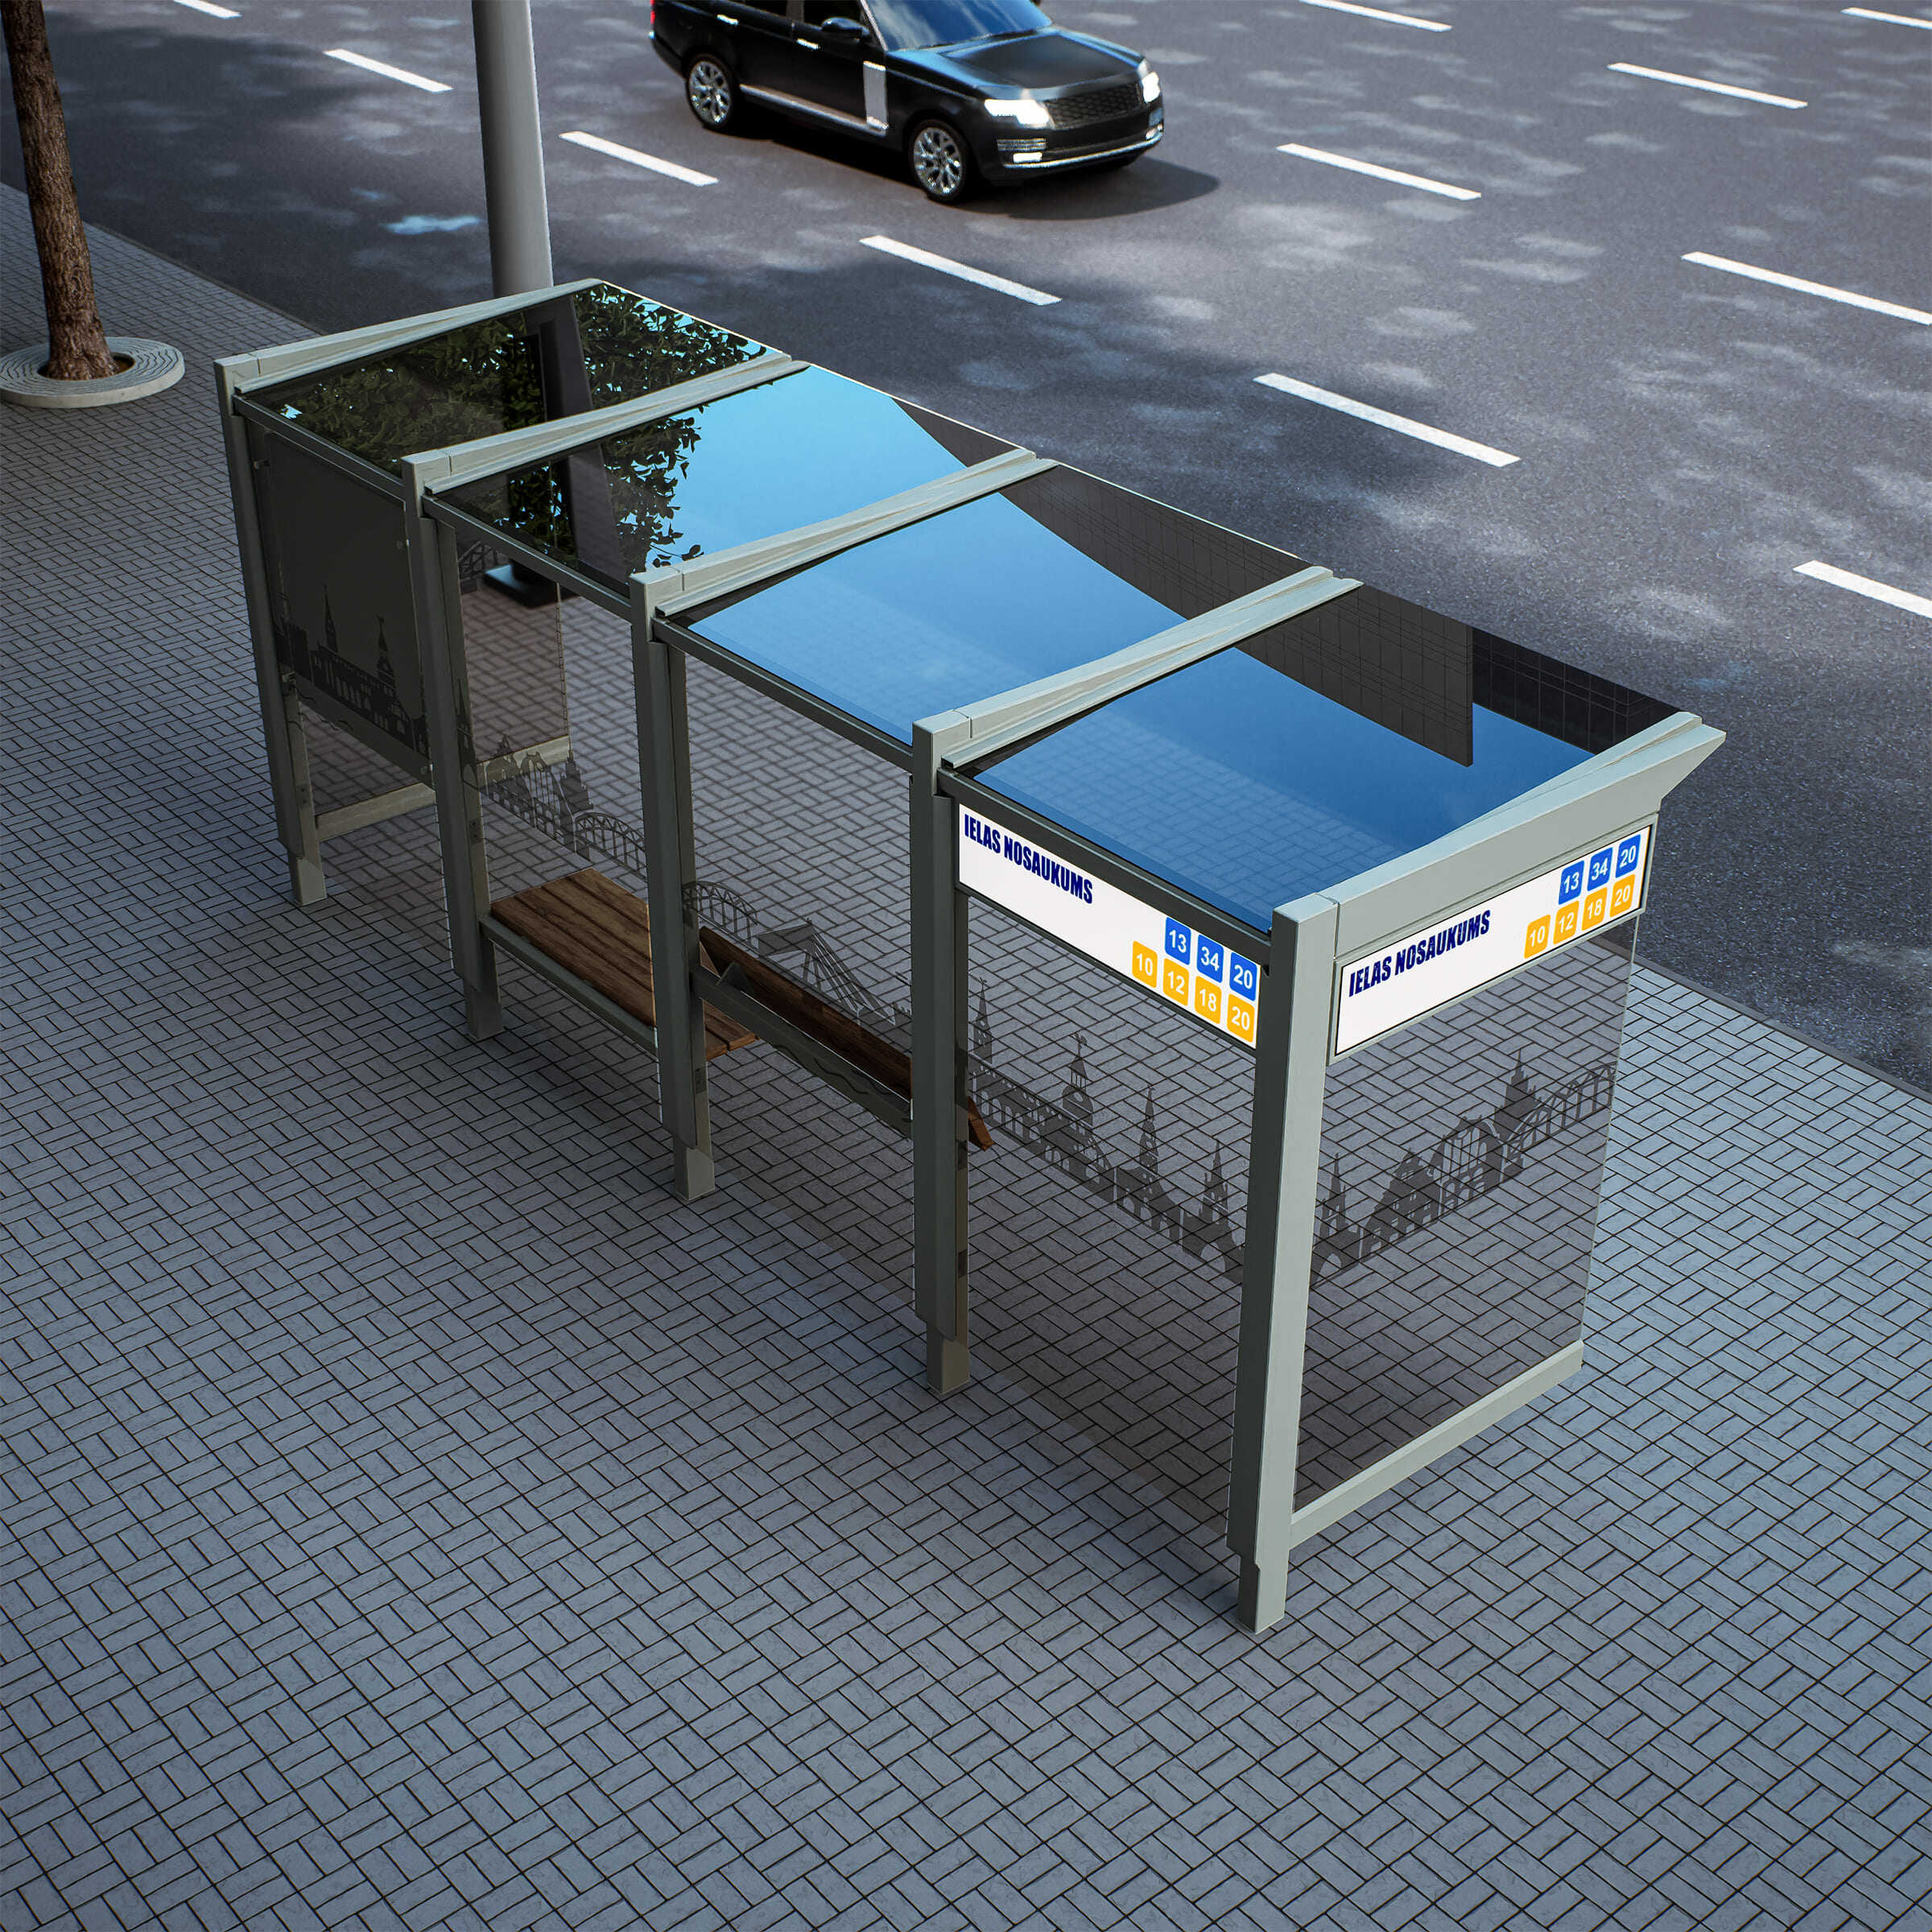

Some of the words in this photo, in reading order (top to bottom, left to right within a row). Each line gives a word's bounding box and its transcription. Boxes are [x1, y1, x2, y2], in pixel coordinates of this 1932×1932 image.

[964, 813, 1001, 854] IELAS
[1004, 835, 1093, 904] NOSAUKUMS
[1563, 872, 1579, 894] 13
[1591, 858, 1608, 881] 34
[1619, 845, 1637, 868] 20
[1530, 925, 1546, 947] 10
[1558, 912, 1575, 933] 12
[1587, 898, 1603, 919] 18
[1614, 886, 1631, 907] 20
[1169, 930, 1187, 953] 13
[1201, 946, 1220, 971] 34
[1233, 964, 1253, 989] 20
[1348, 956, 1392, 997] IELAS
[1394, 910, 1491, 976] NOSAUKUMS
[1136, 953, 1154, 976] 10
[1167, 971, 1185, 995] 12
[1199, 989, 1216, 1012] 18
[1231, 1006, 1250, 1031] 20
